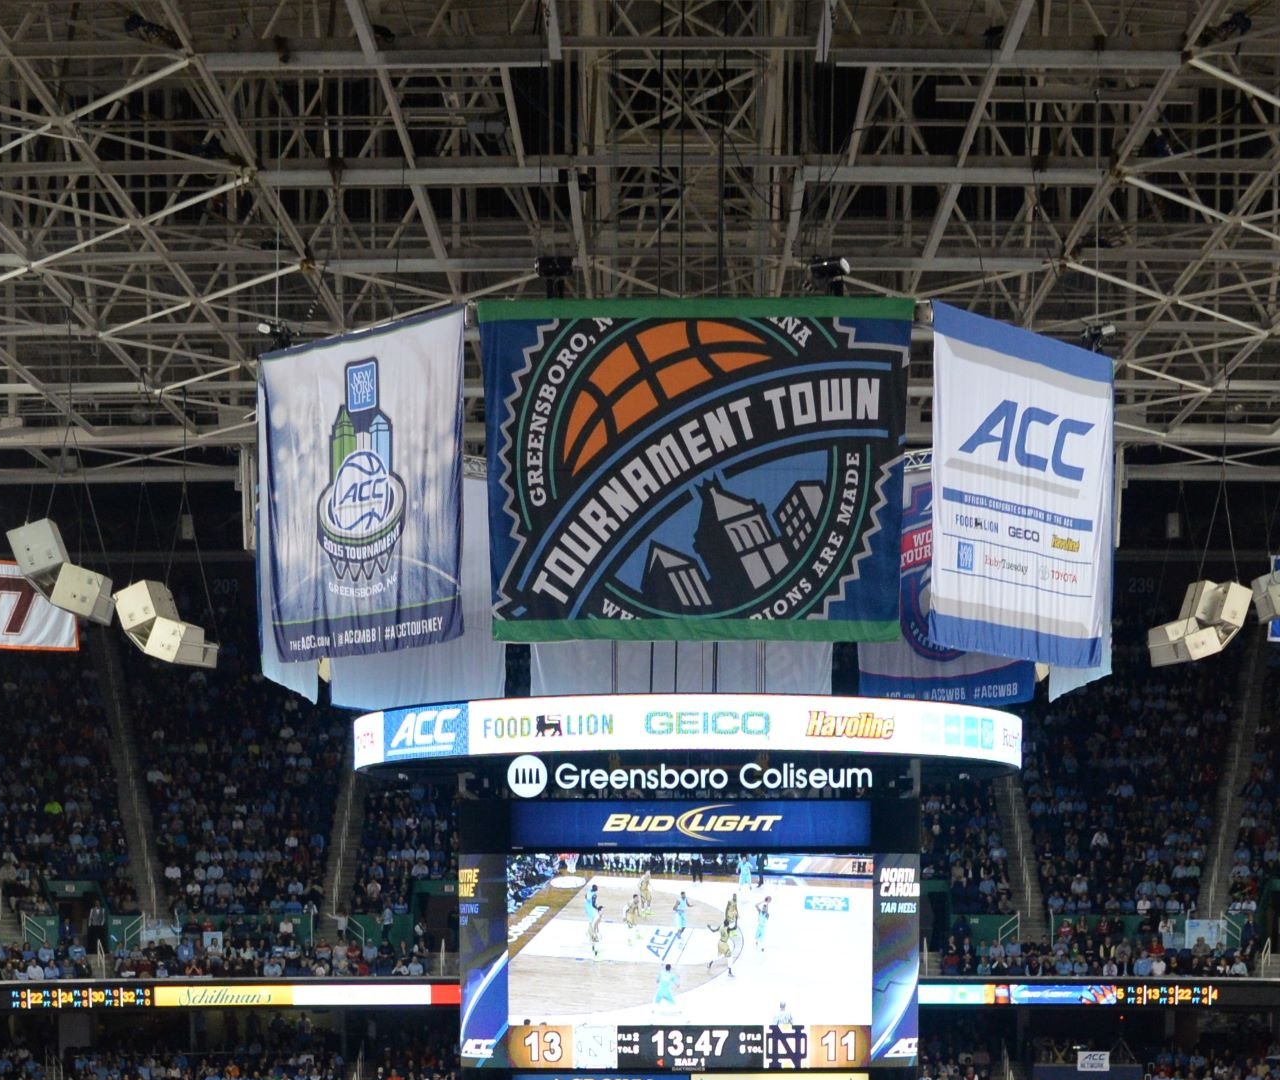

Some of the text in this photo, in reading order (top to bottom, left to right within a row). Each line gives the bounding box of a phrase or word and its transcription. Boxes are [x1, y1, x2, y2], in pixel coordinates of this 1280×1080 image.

[350, 379, 374, 395] YORK
[352, 369, 372, 383] NEW
[353, 393, 372, 405] LIFE
[958, 399, 1095, 482] ACC
[339, 477, 388, 505] ACC
[532, 378, 881, 605] TOURNAMENT TOWN
[836, 451, 861, 527] MADE
[323, 521, 401, 561] 2015 TOURNAMENT
[384, 616, 444, 641] #ACCTOURNEY
[389, 707, 462, 748] ACC
[483, 713, 615, 740] FOOD LION
[645, 710, 771, 737] GEICO
[806, 710, 895, 741] Havoline
[554, 762, 874, 790] Greensboro Coliseum
[602, 813, 783, 833] BUD LIGHT
[880, 867, 915, 883] NORTH
[880, 902, 917, 914] TAR HEELS
[30, 992, 43, 1004] 22
[61, 992, 74, 1003] 24
[92, 991, 105, 1002] 30
[123, 991, 135, 1002] 32
[461, 1038, 496, 1054] ACC
[523, 1031, 563, 1062] 13
[651, 1029, 730, 1057] 13:47
[820, 1030, 857, 1062] 11
[1083, 1053, 1106, 1061] ACC
